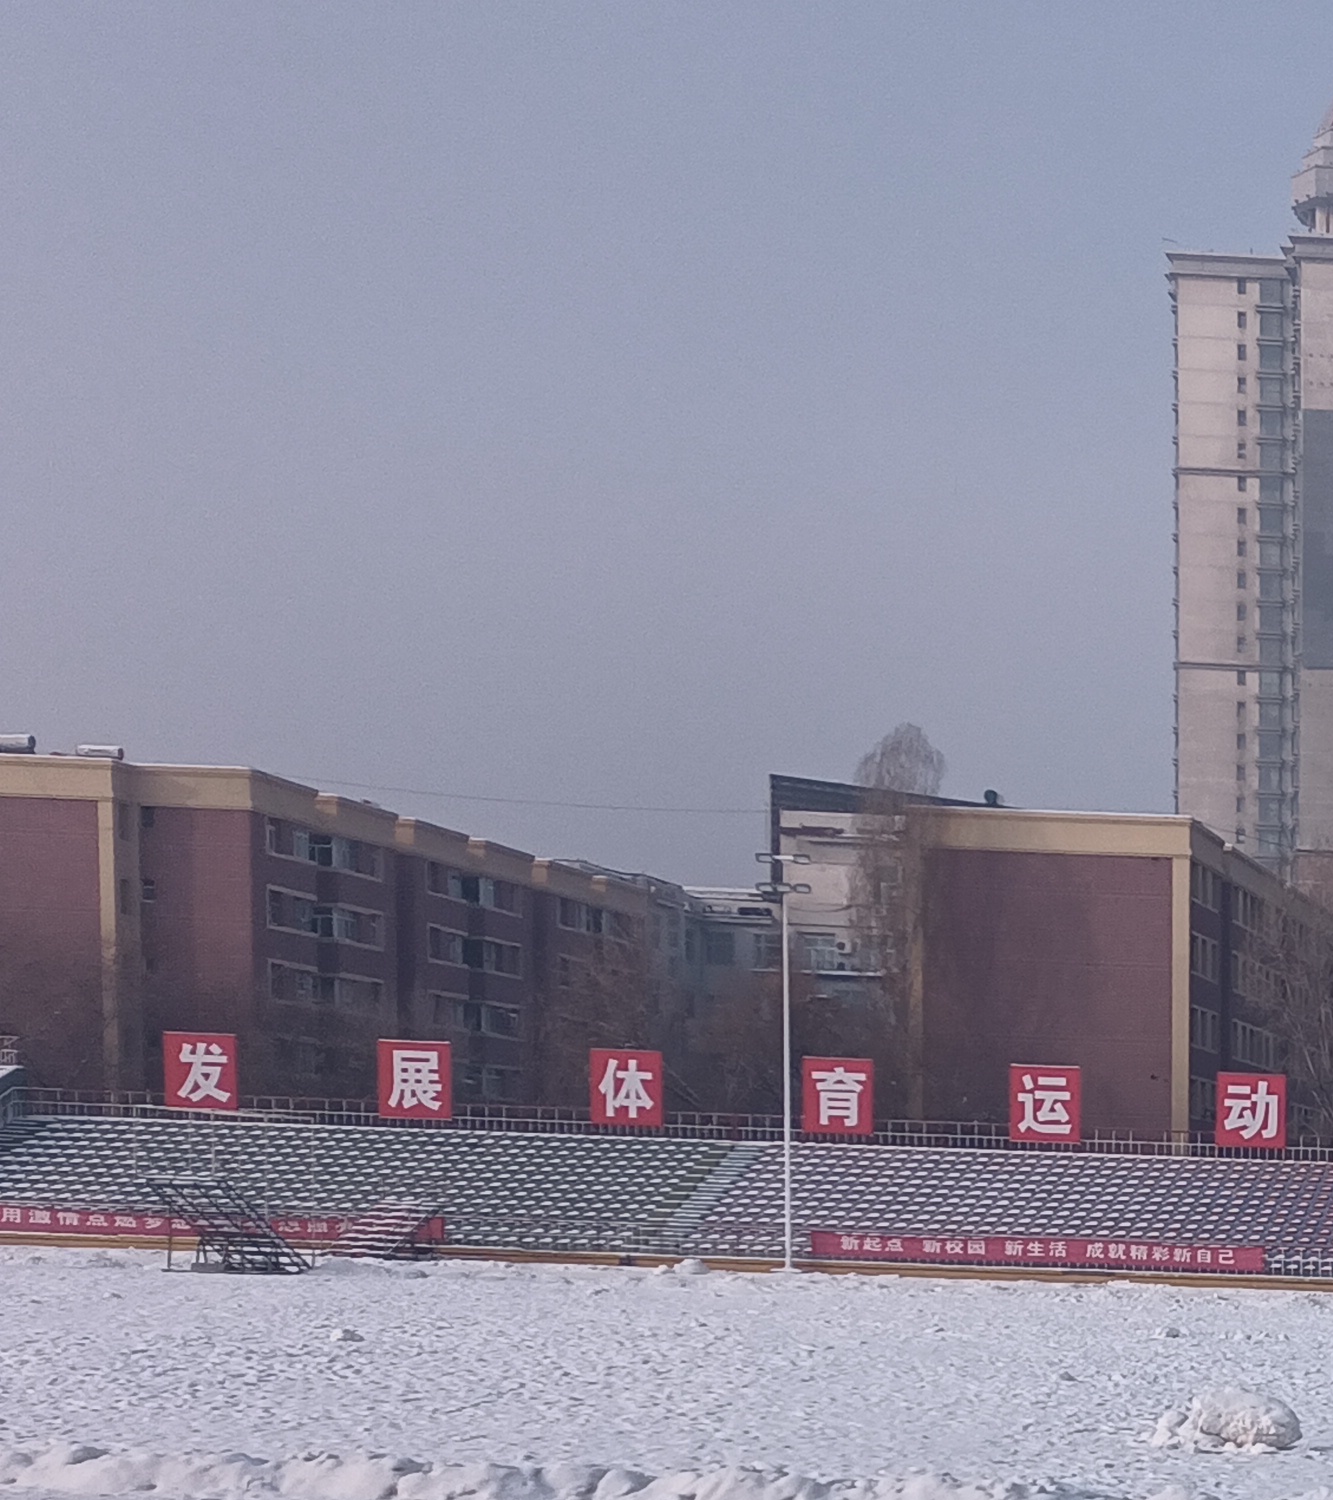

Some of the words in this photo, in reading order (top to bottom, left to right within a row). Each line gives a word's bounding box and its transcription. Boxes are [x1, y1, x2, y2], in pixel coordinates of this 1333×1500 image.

[176, 1041, 232, 1104] 发
[387, 1048, 444, 1111] 展
[597, 1057, 655, 1120] 体
[810, 1065, 867, 1128] 育
[1016, 1072, 1074, 1135] 运
[1223, 1079, 1280, 1141] 动
[840, 1235, 904, 1253] 新起点
[922, 1239, 986, 1256] 新校园
[1004, 1240, 1068, 1258] 新生活
[1085, 1242, 1236, 1264] 成就精彩新自己
